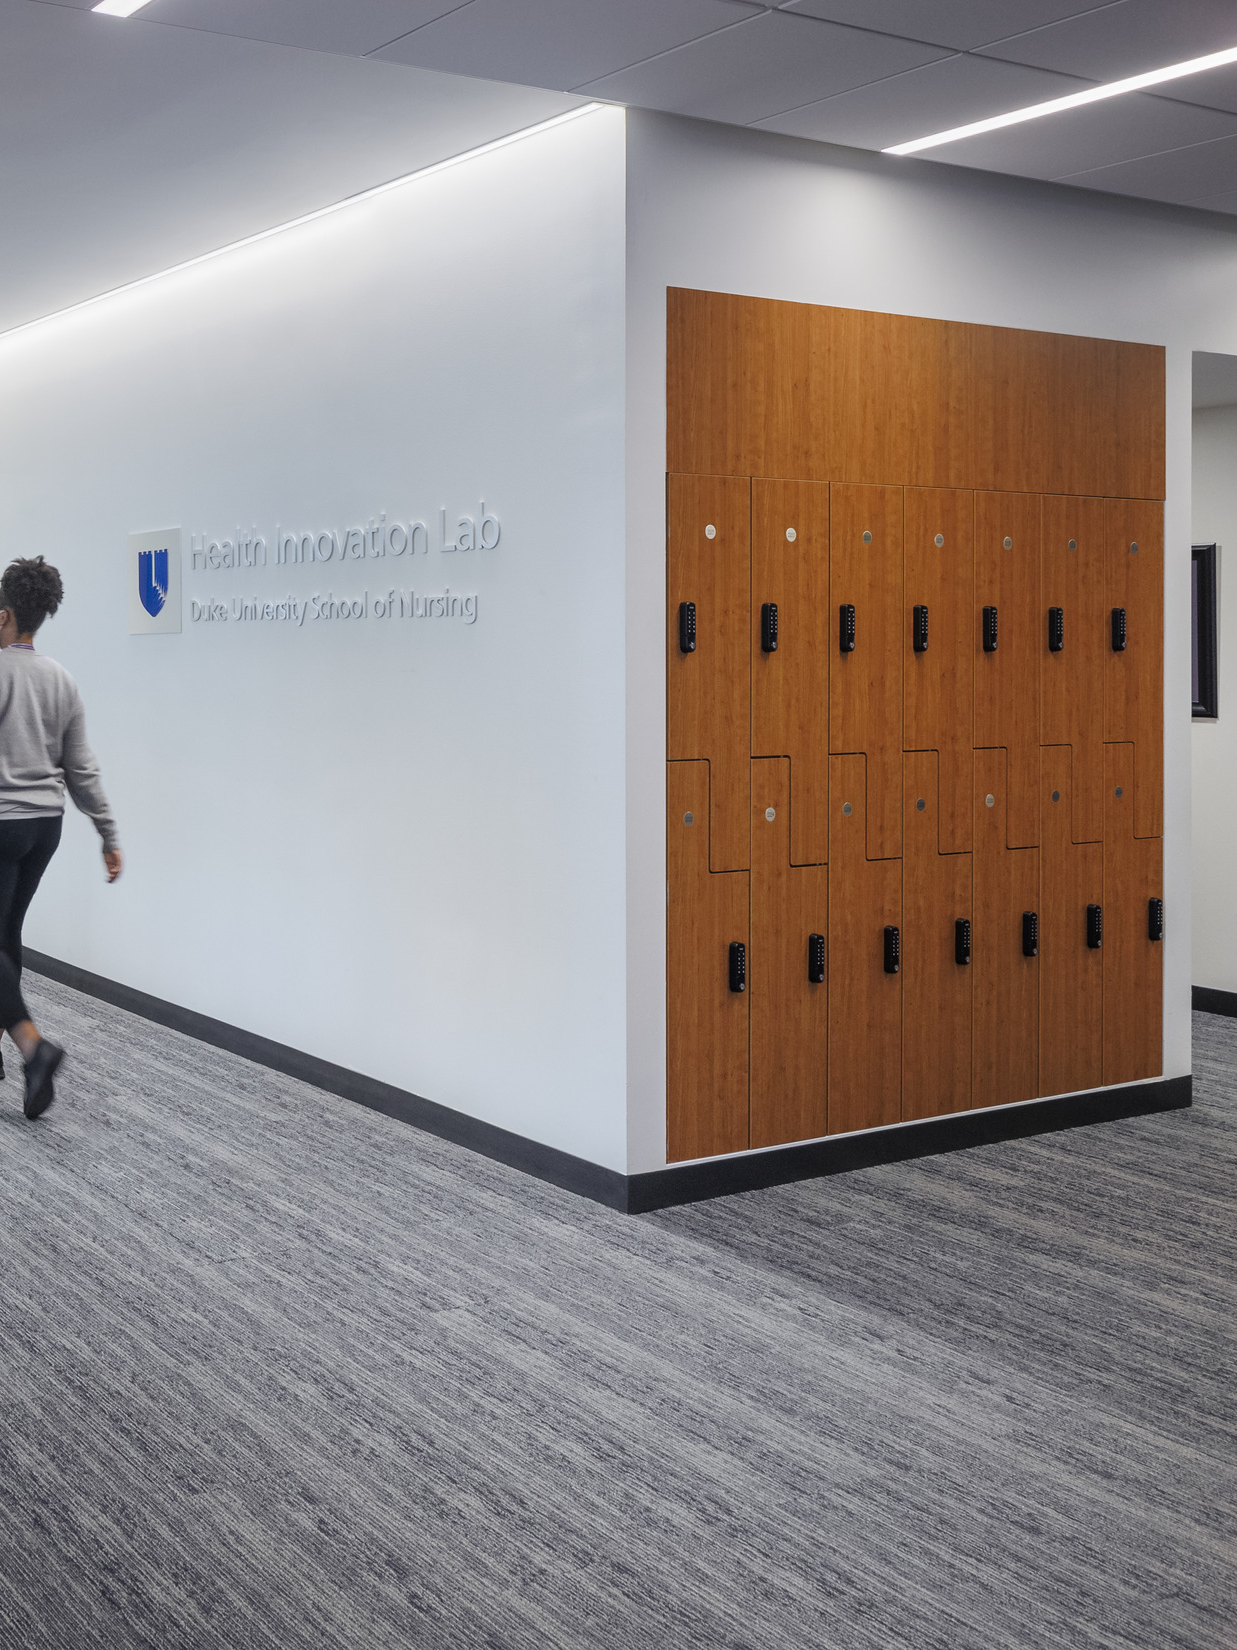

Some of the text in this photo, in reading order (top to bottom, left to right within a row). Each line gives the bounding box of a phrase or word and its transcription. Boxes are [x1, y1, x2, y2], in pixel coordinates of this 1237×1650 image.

[191, 499, 501, 570] Health Innovation Lab
[191, 586, 478, 627] Duke University School of Nursing
